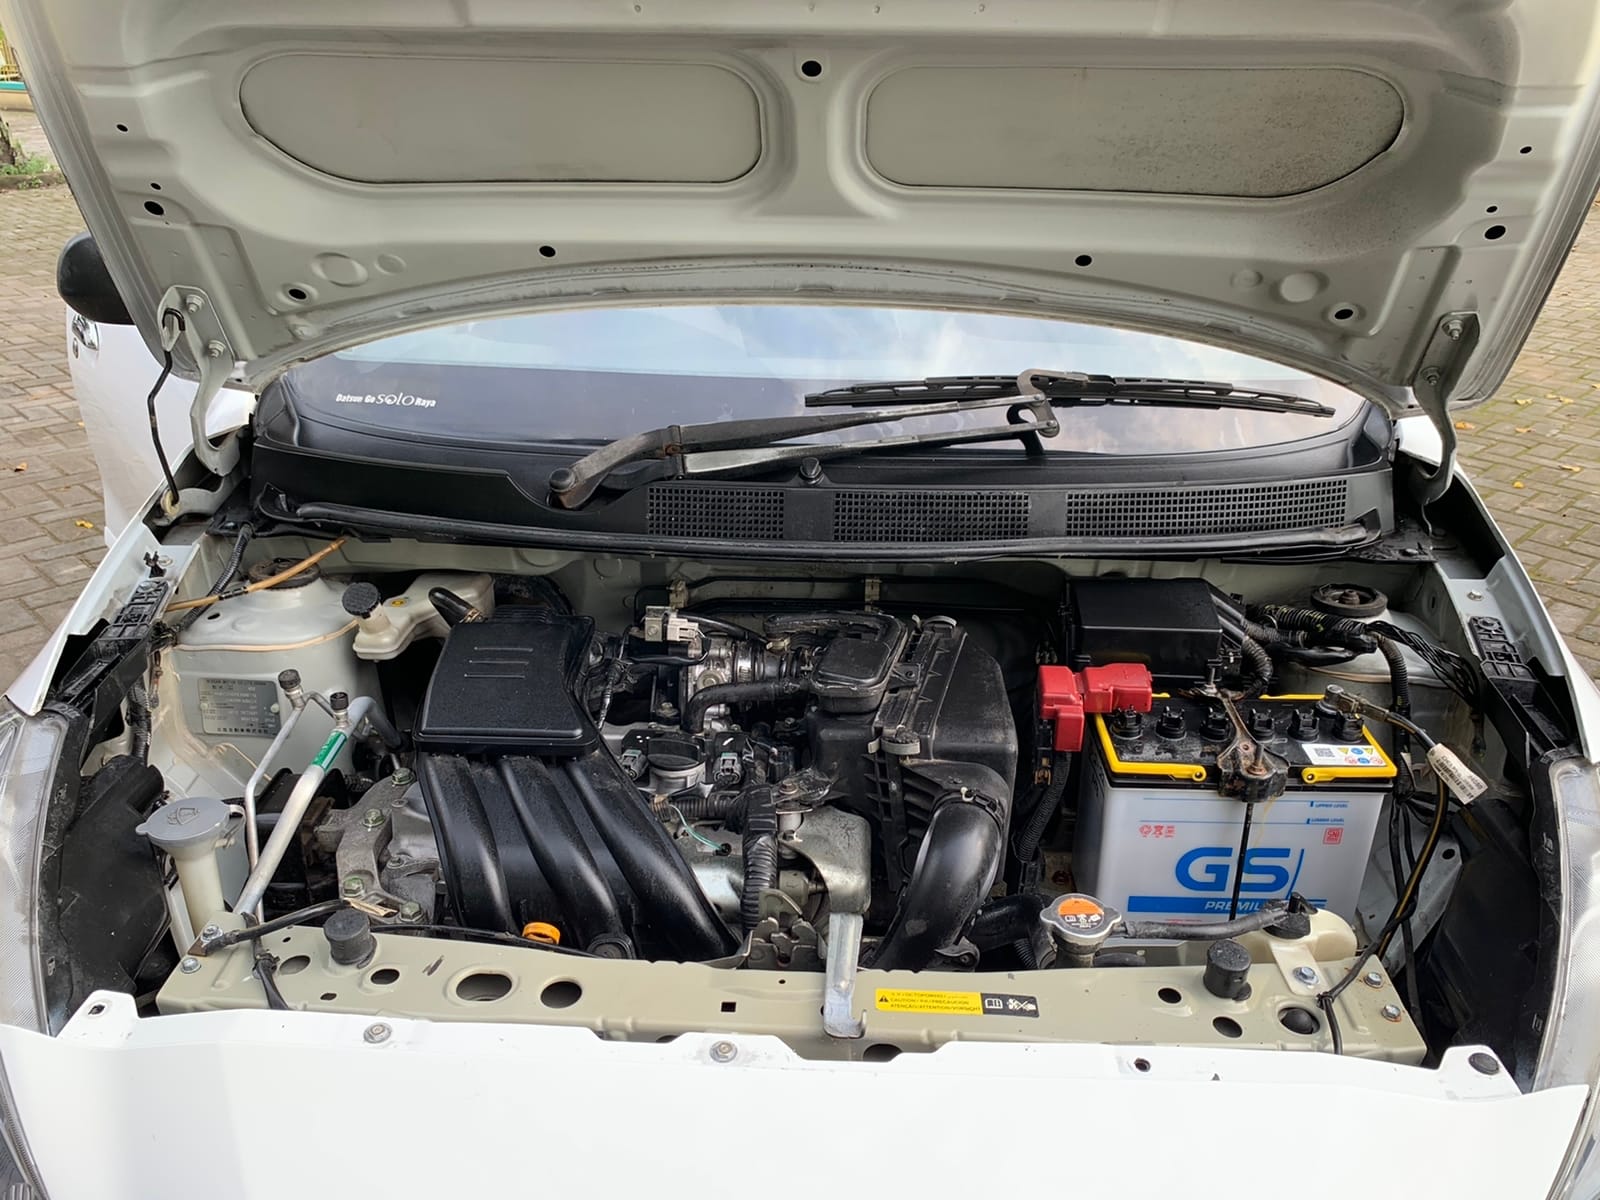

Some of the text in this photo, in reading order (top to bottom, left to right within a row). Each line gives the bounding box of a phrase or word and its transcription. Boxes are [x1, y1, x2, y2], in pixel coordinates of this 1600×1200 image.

[335, 394, 363, 403] Datsun
[364, 395, 376, 404] Go
[414, 397, 437, 408] Raya
[1175, 847, 1291, 892] GS
